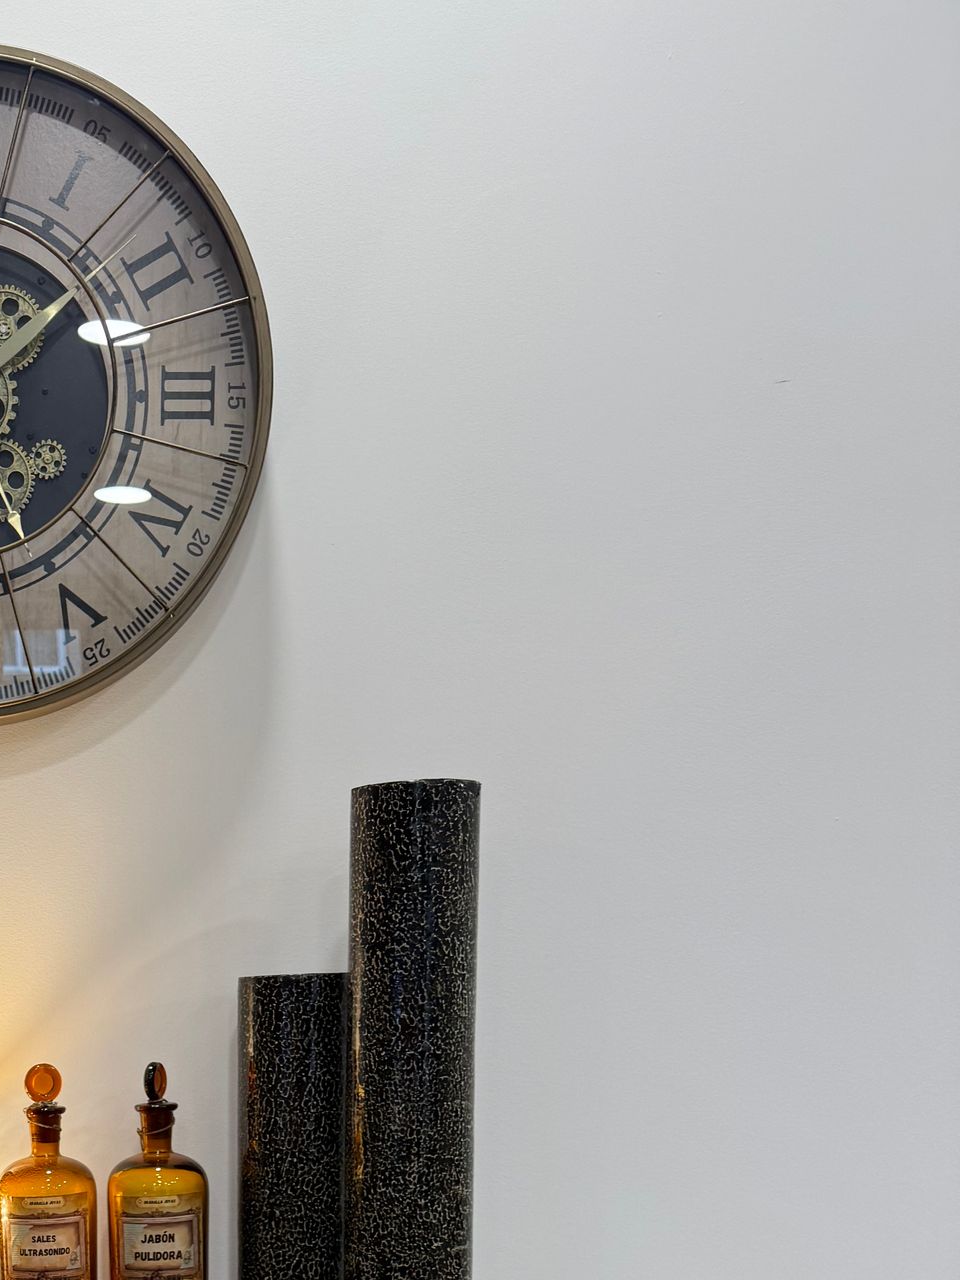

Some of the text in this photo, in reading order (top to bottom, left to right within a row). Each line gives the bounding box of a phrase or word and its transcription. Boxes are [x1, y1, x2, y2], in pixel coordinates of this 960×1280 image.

[83, 119, 112, 145] 05
[49, 150, 93, 212] I
[186, 230, 213, 260] 10
[120, 231, 195, 311] II
[161, 365, 216, 426] III
[226, 381, 246, 411] 15
[128, 479, 195, 557] IV
[186, 527, 211, 558] 20
[58, 583, 108, 646] V
[82, 637, 111, 667] 25
[19, 1246, 71, 1257] ULTRASONIDO
[31, 1234, 57, 1244] SALES
[140, 1231, 176, 1244] JABÓN
[134, 1249, 183, 1262] PULIDORA
